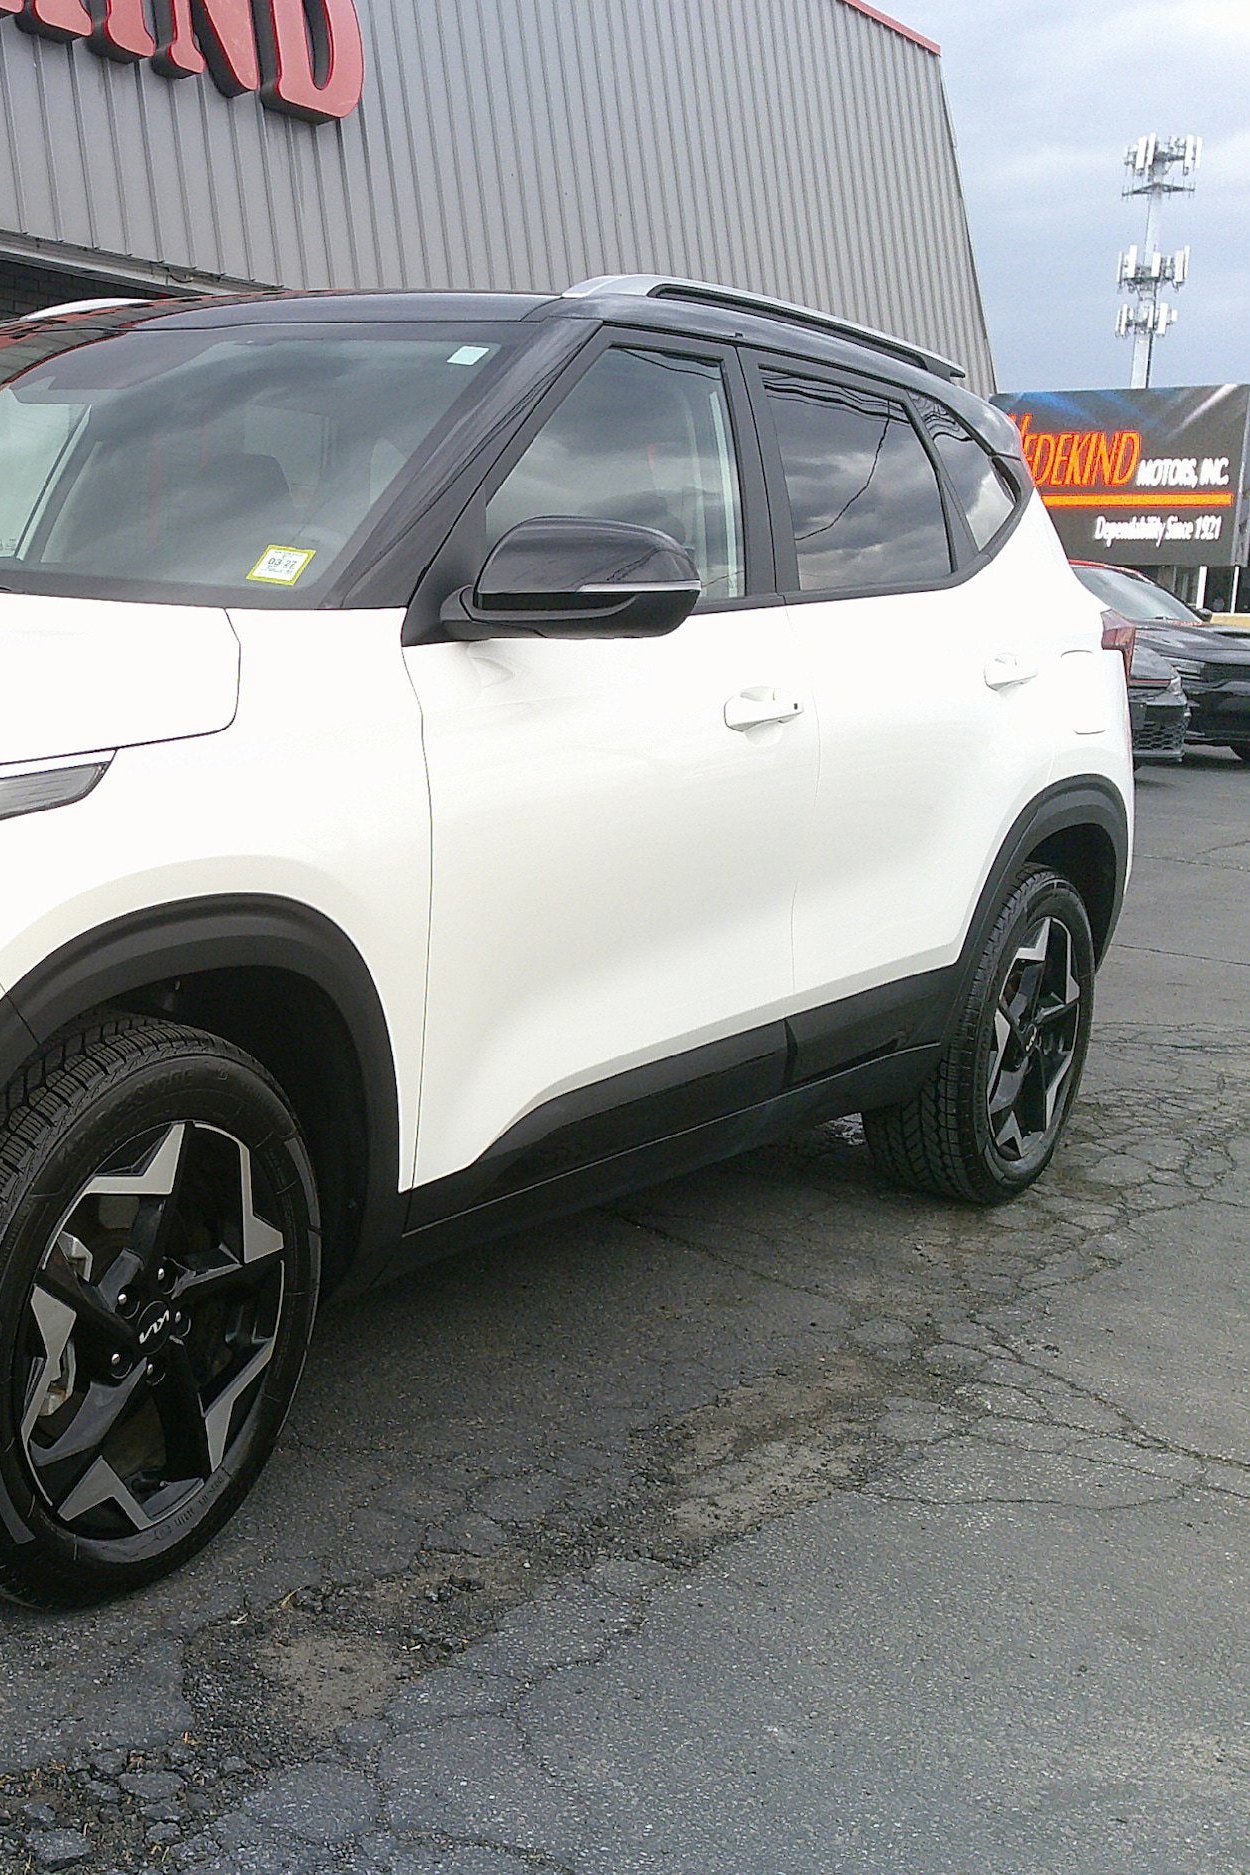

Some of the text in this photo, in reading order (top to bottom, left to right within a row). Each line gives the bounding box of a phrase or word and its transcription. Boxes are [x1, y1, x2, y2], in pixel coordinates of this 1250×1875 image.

[1199, 457, 1230, 486] INC.
[1094, 515, 1222, 547] Dependability Since 1921
